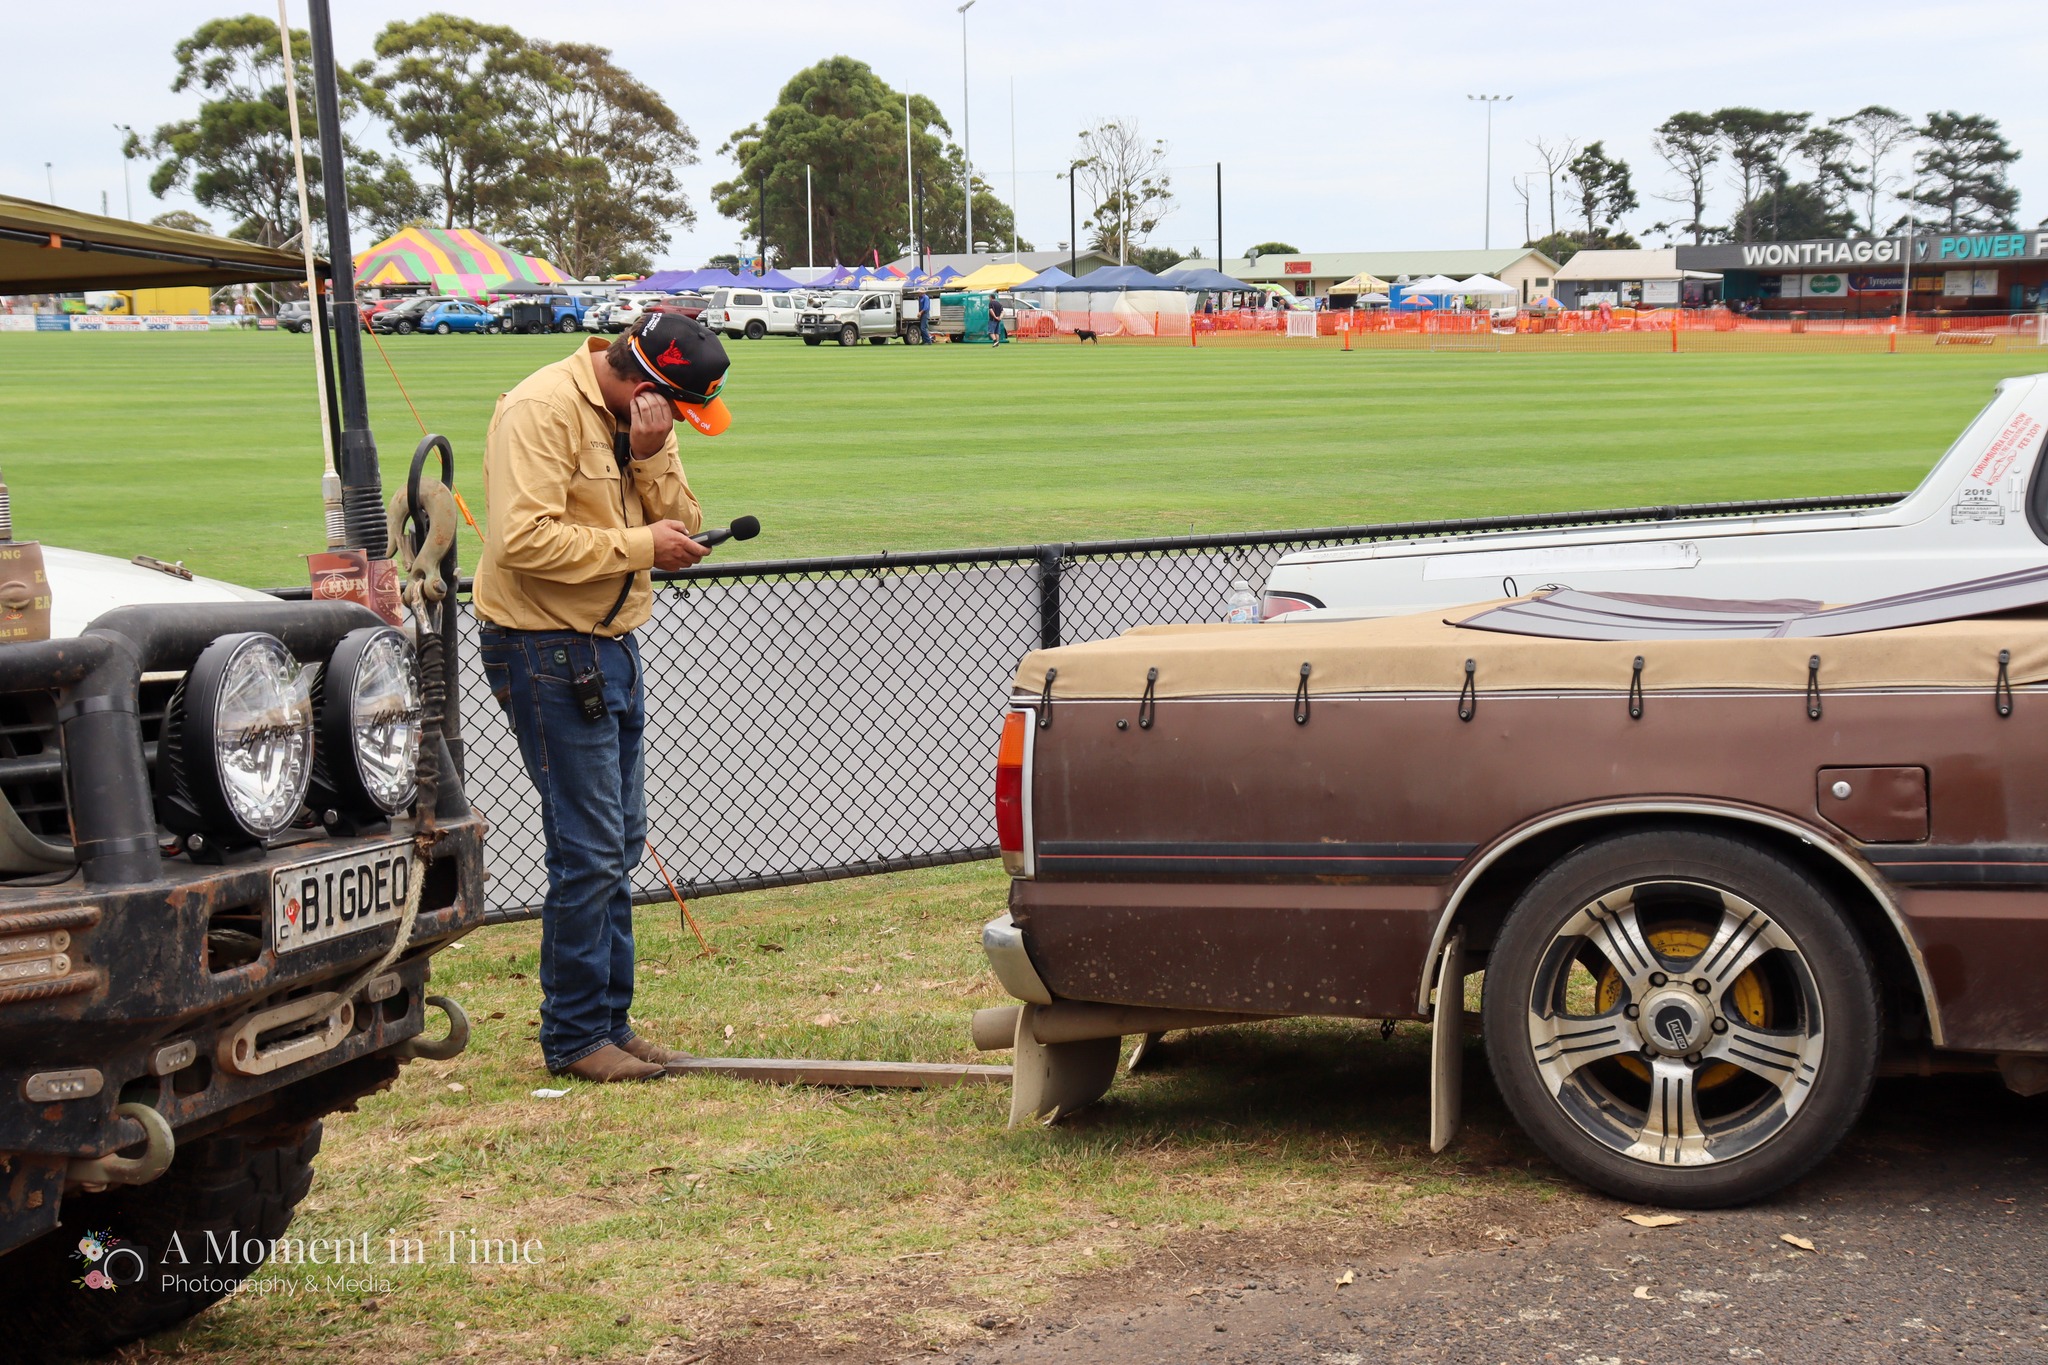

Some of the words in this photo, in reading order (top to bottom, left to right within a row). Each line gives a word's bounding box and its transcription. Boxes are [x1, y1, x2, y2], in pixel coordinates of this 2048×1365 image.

[1743, 239, 1901, 265] WONTHAGGI
[1941, 234, 2026, 259] POWER
[1971, 439, 2006, 478] KORUMBURRA
[2002, 428, 2015, 440] UTE
[2010, 412, 2028, 428] SHOW
[2017, 437, 2031, 449] FEB
[2026, 423, 2042, 437] 2019
[1964, 488, 1993, 496] 2019
[301, 855, 408, 934] BIGDEO
[1670, 1023, 1688, 1049] ALLIED
